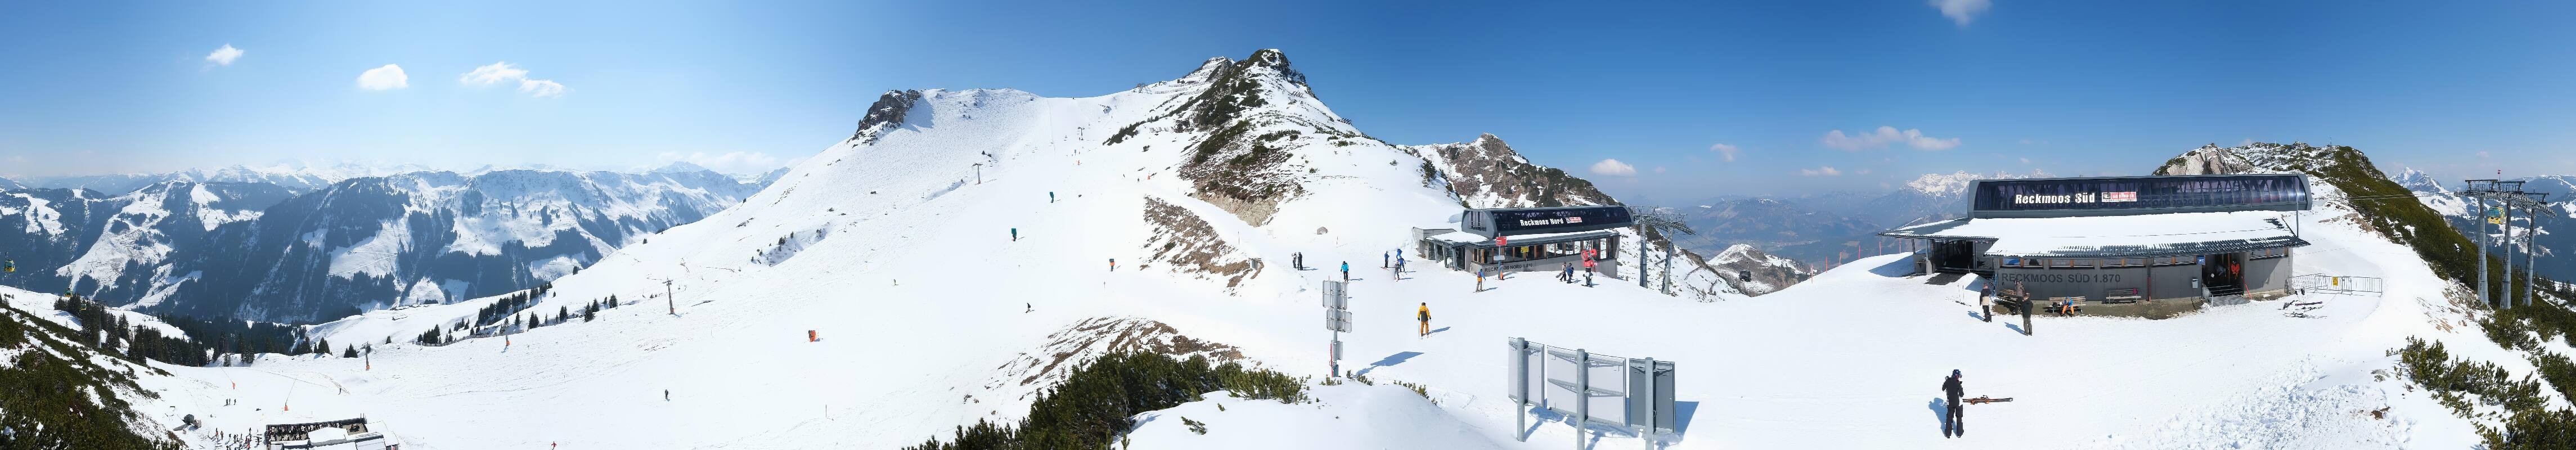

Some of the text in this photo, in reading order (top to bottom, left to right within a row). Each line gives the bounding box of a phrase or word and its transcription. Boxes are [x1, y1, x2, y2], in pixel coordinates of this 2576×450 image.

[2016, 192, 2095, 204] Reckmoos Süd
[2002, 273, 2120, 283] RECKMOOS SÜD 1.870
